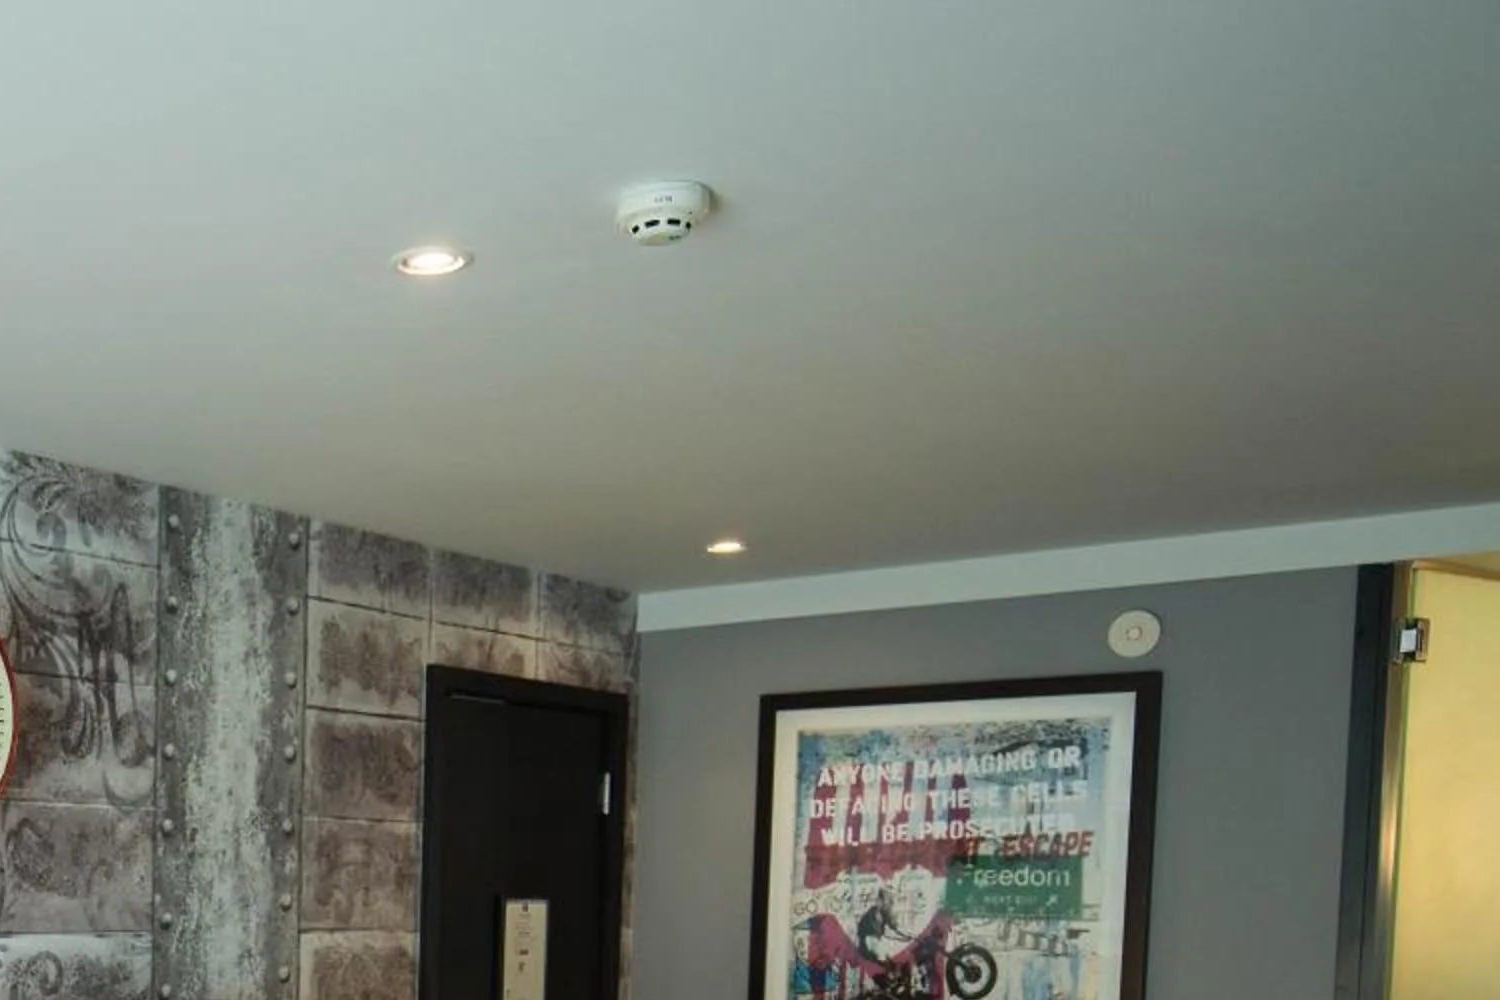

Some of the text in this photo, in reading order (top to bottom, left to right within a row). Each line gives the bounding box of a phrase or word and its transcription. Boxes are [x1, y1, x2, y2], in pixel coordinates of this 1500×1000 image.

[818, 744, 1080, 786] ANYONE DAMAGING OR
[882, 823, 913, 844] BE
